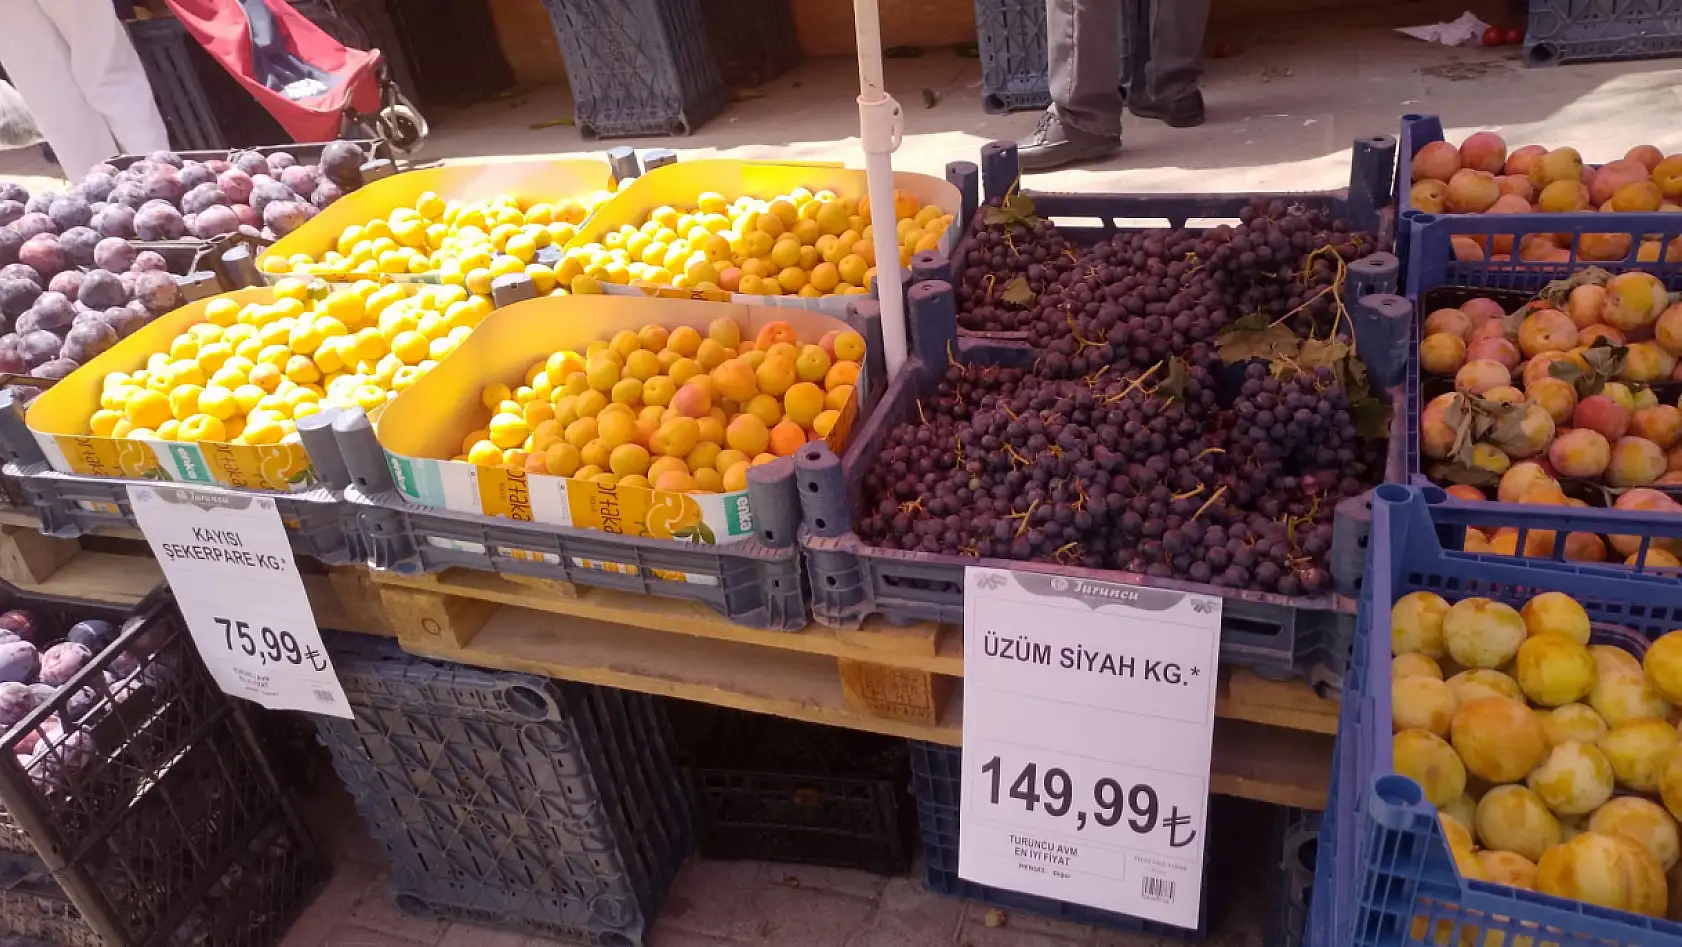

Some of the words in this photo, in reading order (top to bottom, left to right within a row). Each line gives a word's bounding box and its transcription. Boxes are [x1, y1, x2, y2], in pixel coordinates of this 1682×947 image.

[506, 469, 532, 522] ortaka
[597, 482, 624, 535] ortaka
[736, 496, 753, 531] enka
[192, 527, 243, 547] KAYISI
[163, 543, 256, 568] ŞEKERPARE
[1074, 579, 1140, 601] Turuncu
[984, 631, 1051, 665] ÜZÜM
[1060, 644, 1135, 679] SİYAH
[1009, 835, 1055, 851] TURUNCU
[1057, 844, 1078, 857] AVM
[1014, 846, 1028, 858] EN
